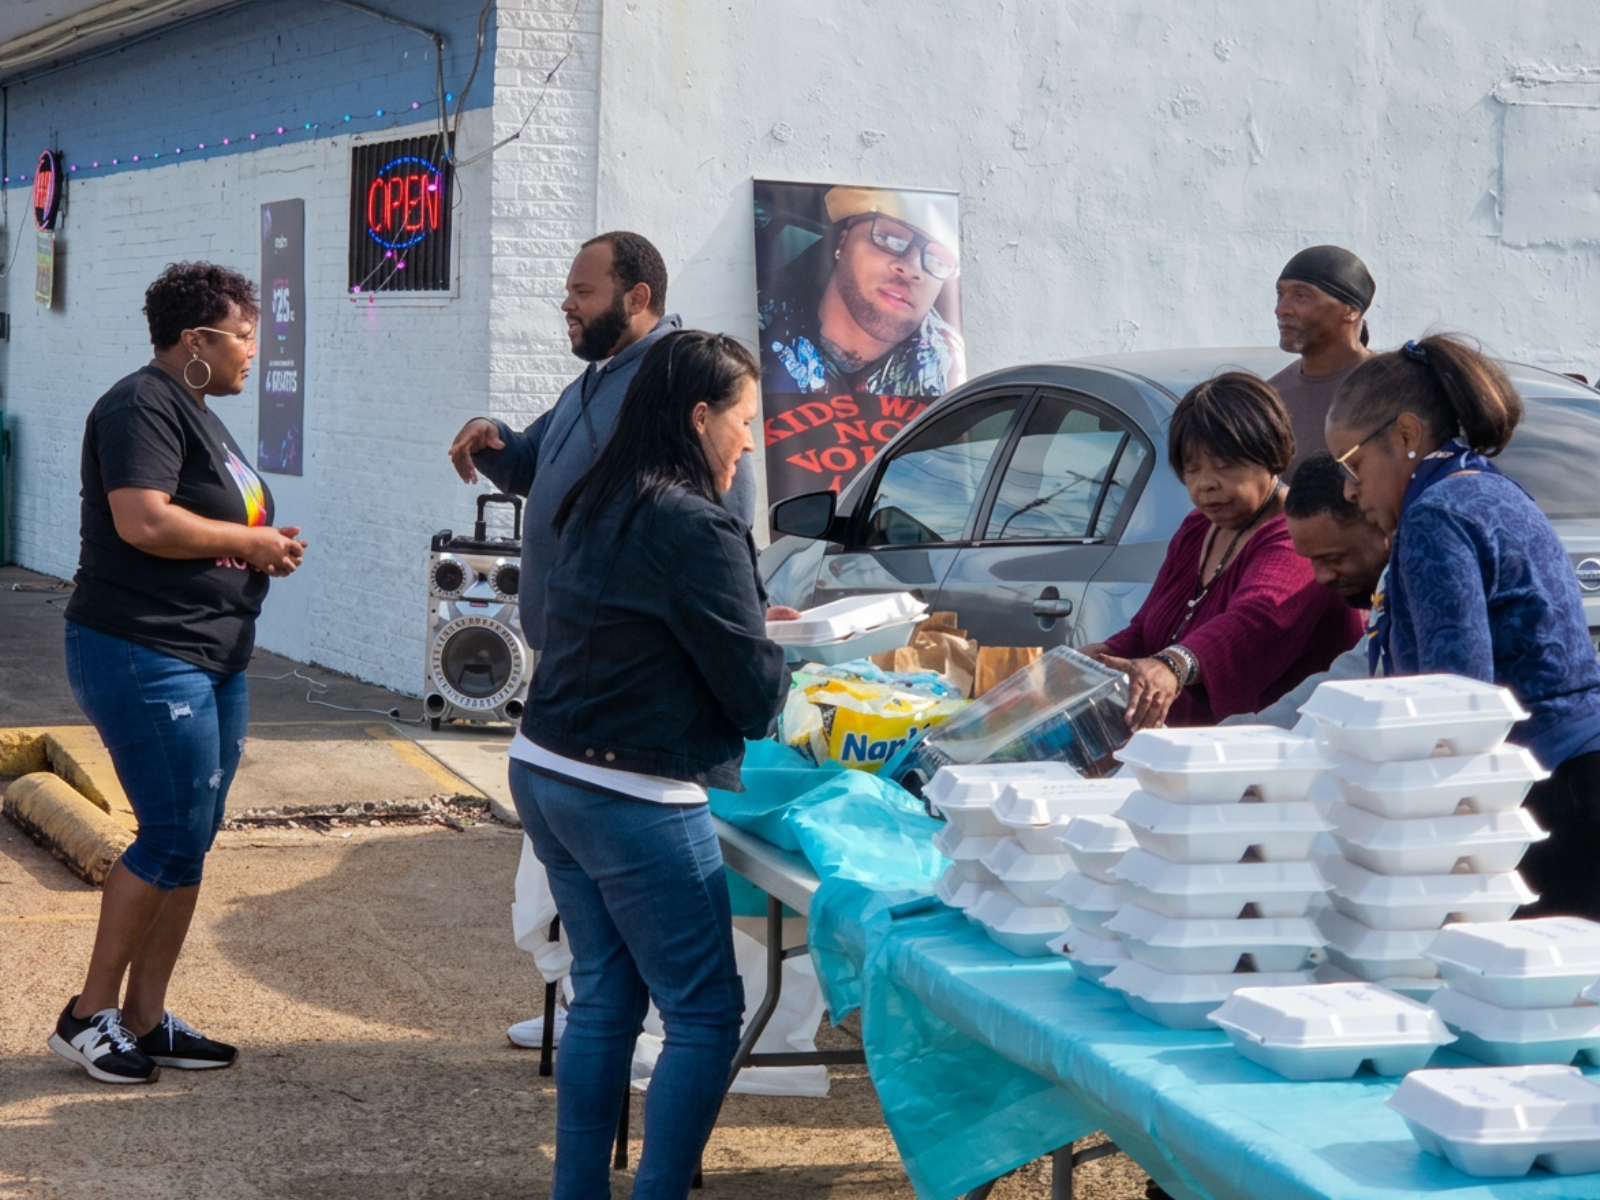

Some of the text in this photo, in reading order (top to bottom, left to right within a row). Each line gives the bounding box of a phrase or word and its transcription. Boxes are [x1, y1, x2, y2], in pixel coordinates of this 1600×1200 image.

[368, 174, 442, 233] OPEN
[764, 394, 860, 446] KIDS
[832, 419, 904, 444] NO
[785, 445, 876, 473] VOI
